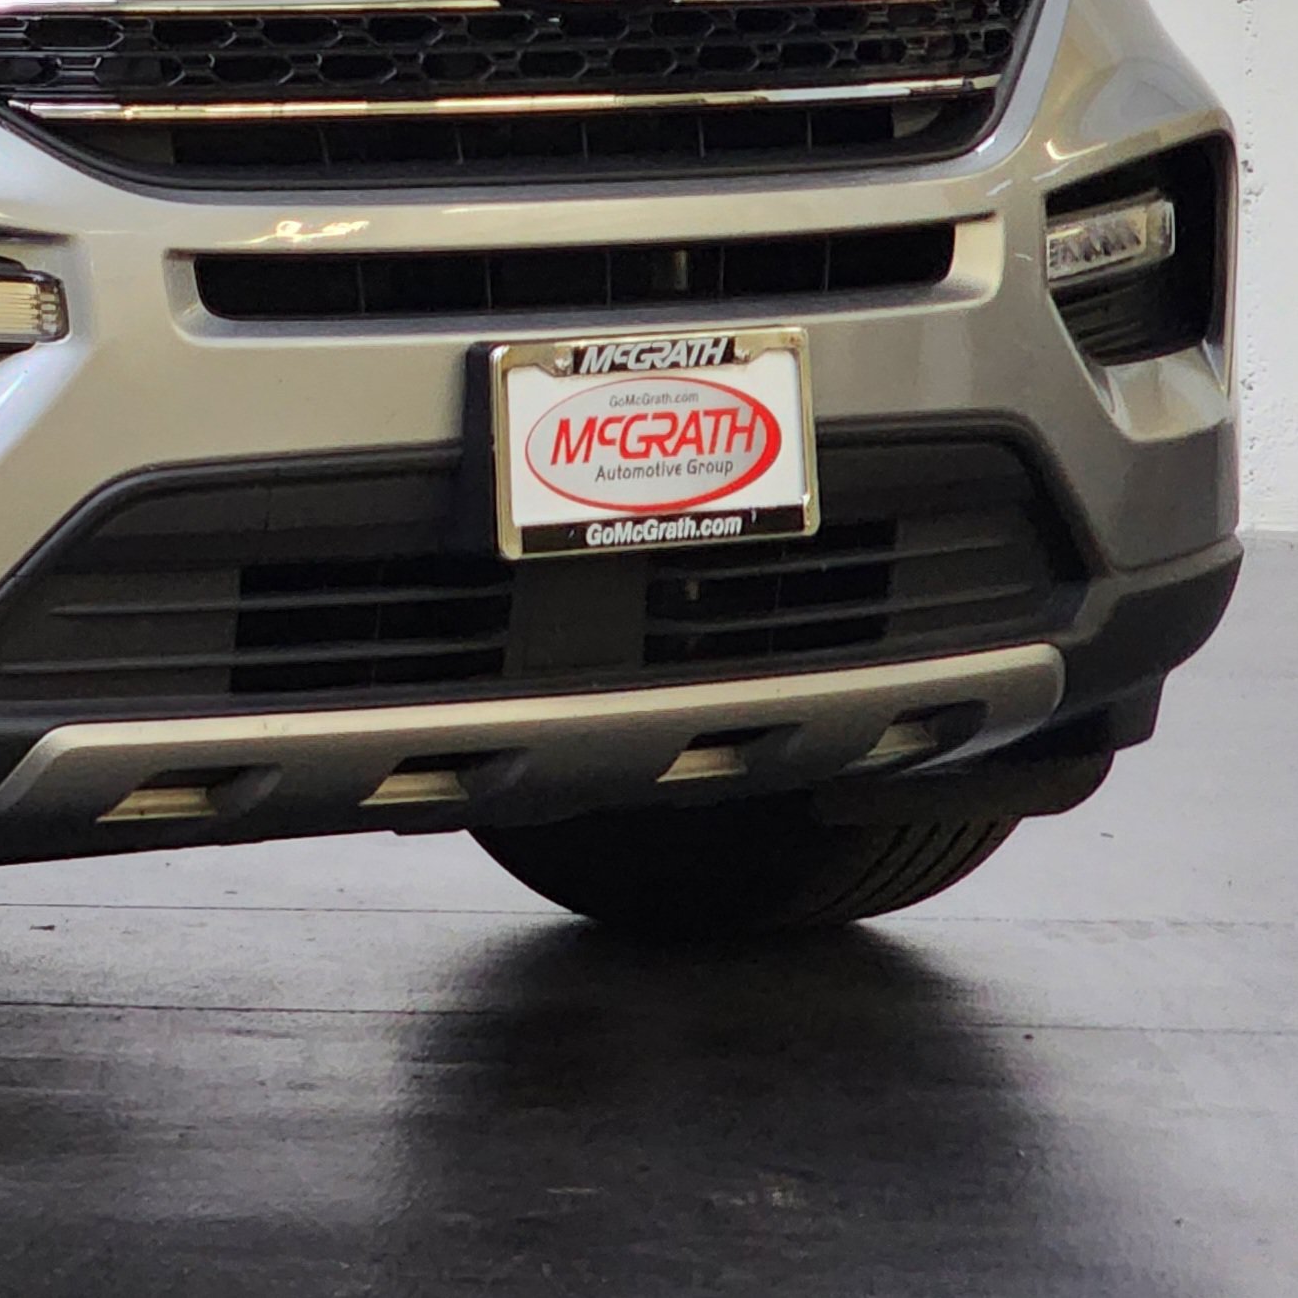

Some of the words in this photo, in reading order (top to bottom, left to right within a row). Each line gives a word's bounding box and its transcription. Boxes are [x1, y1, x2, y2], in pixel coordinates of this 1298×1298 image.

[609, 392, 699, 408] GoMcGrath.com
[595, 460, 682, 483] Automotive
[686, 458, 733, 478] Group
[586, 515, 742, 547] GoMcGrath.com
